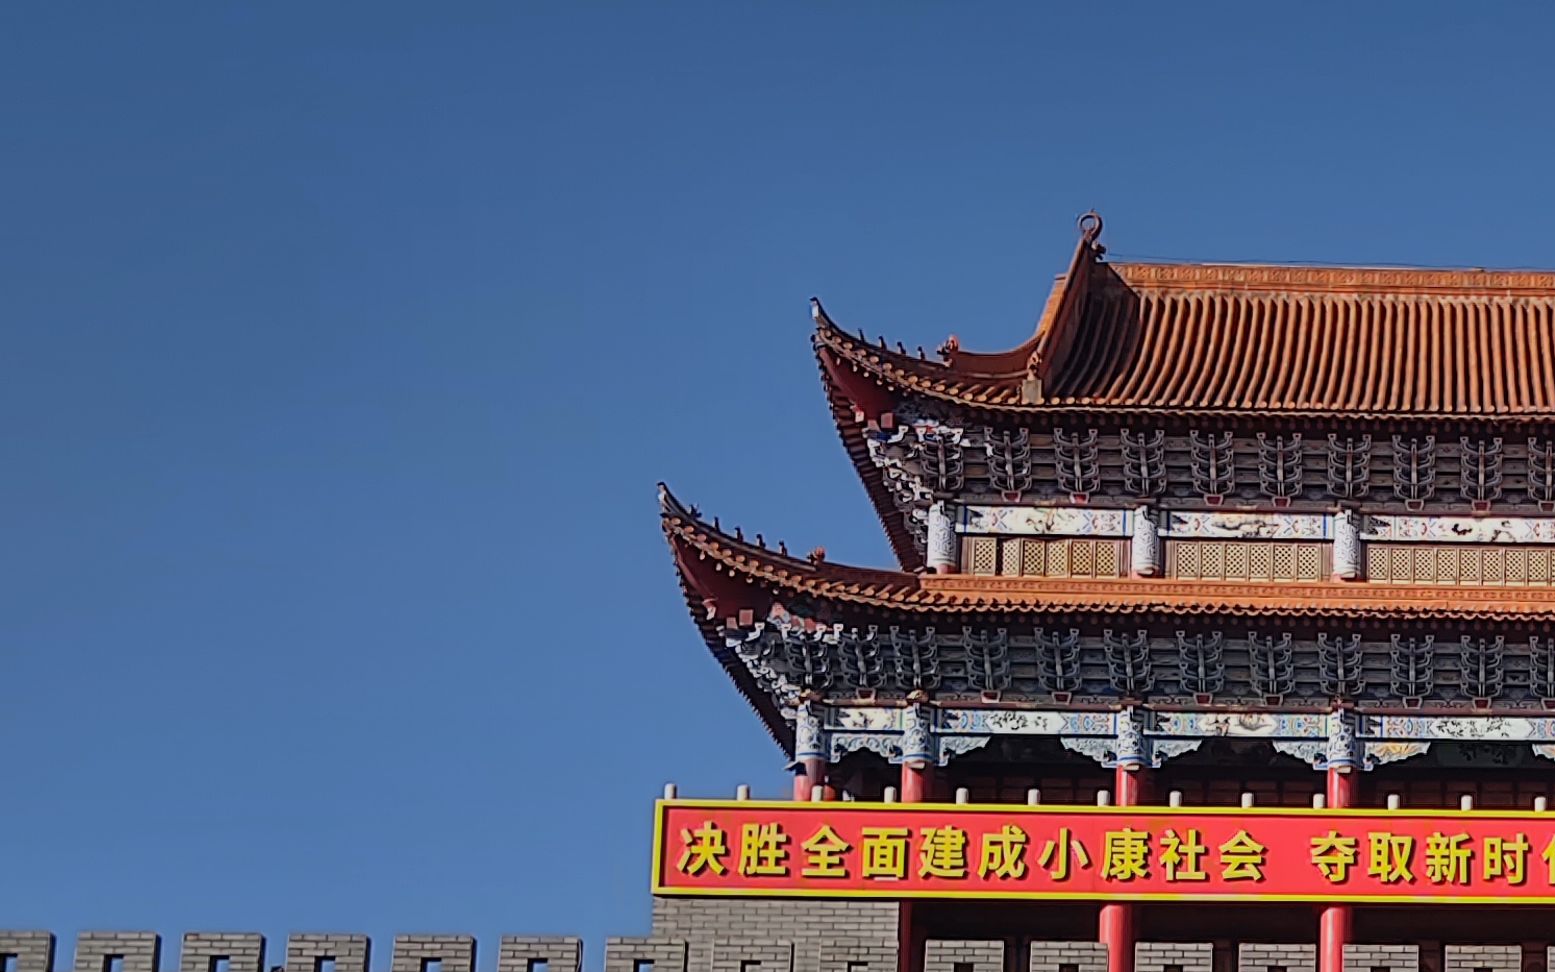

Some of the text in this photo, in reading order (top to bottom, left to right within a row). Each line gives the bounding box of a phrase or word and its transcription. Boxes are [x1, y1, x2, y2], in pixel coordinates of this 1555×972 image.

[678, 822, 1267, 882] 决胜全面建成小康社会
